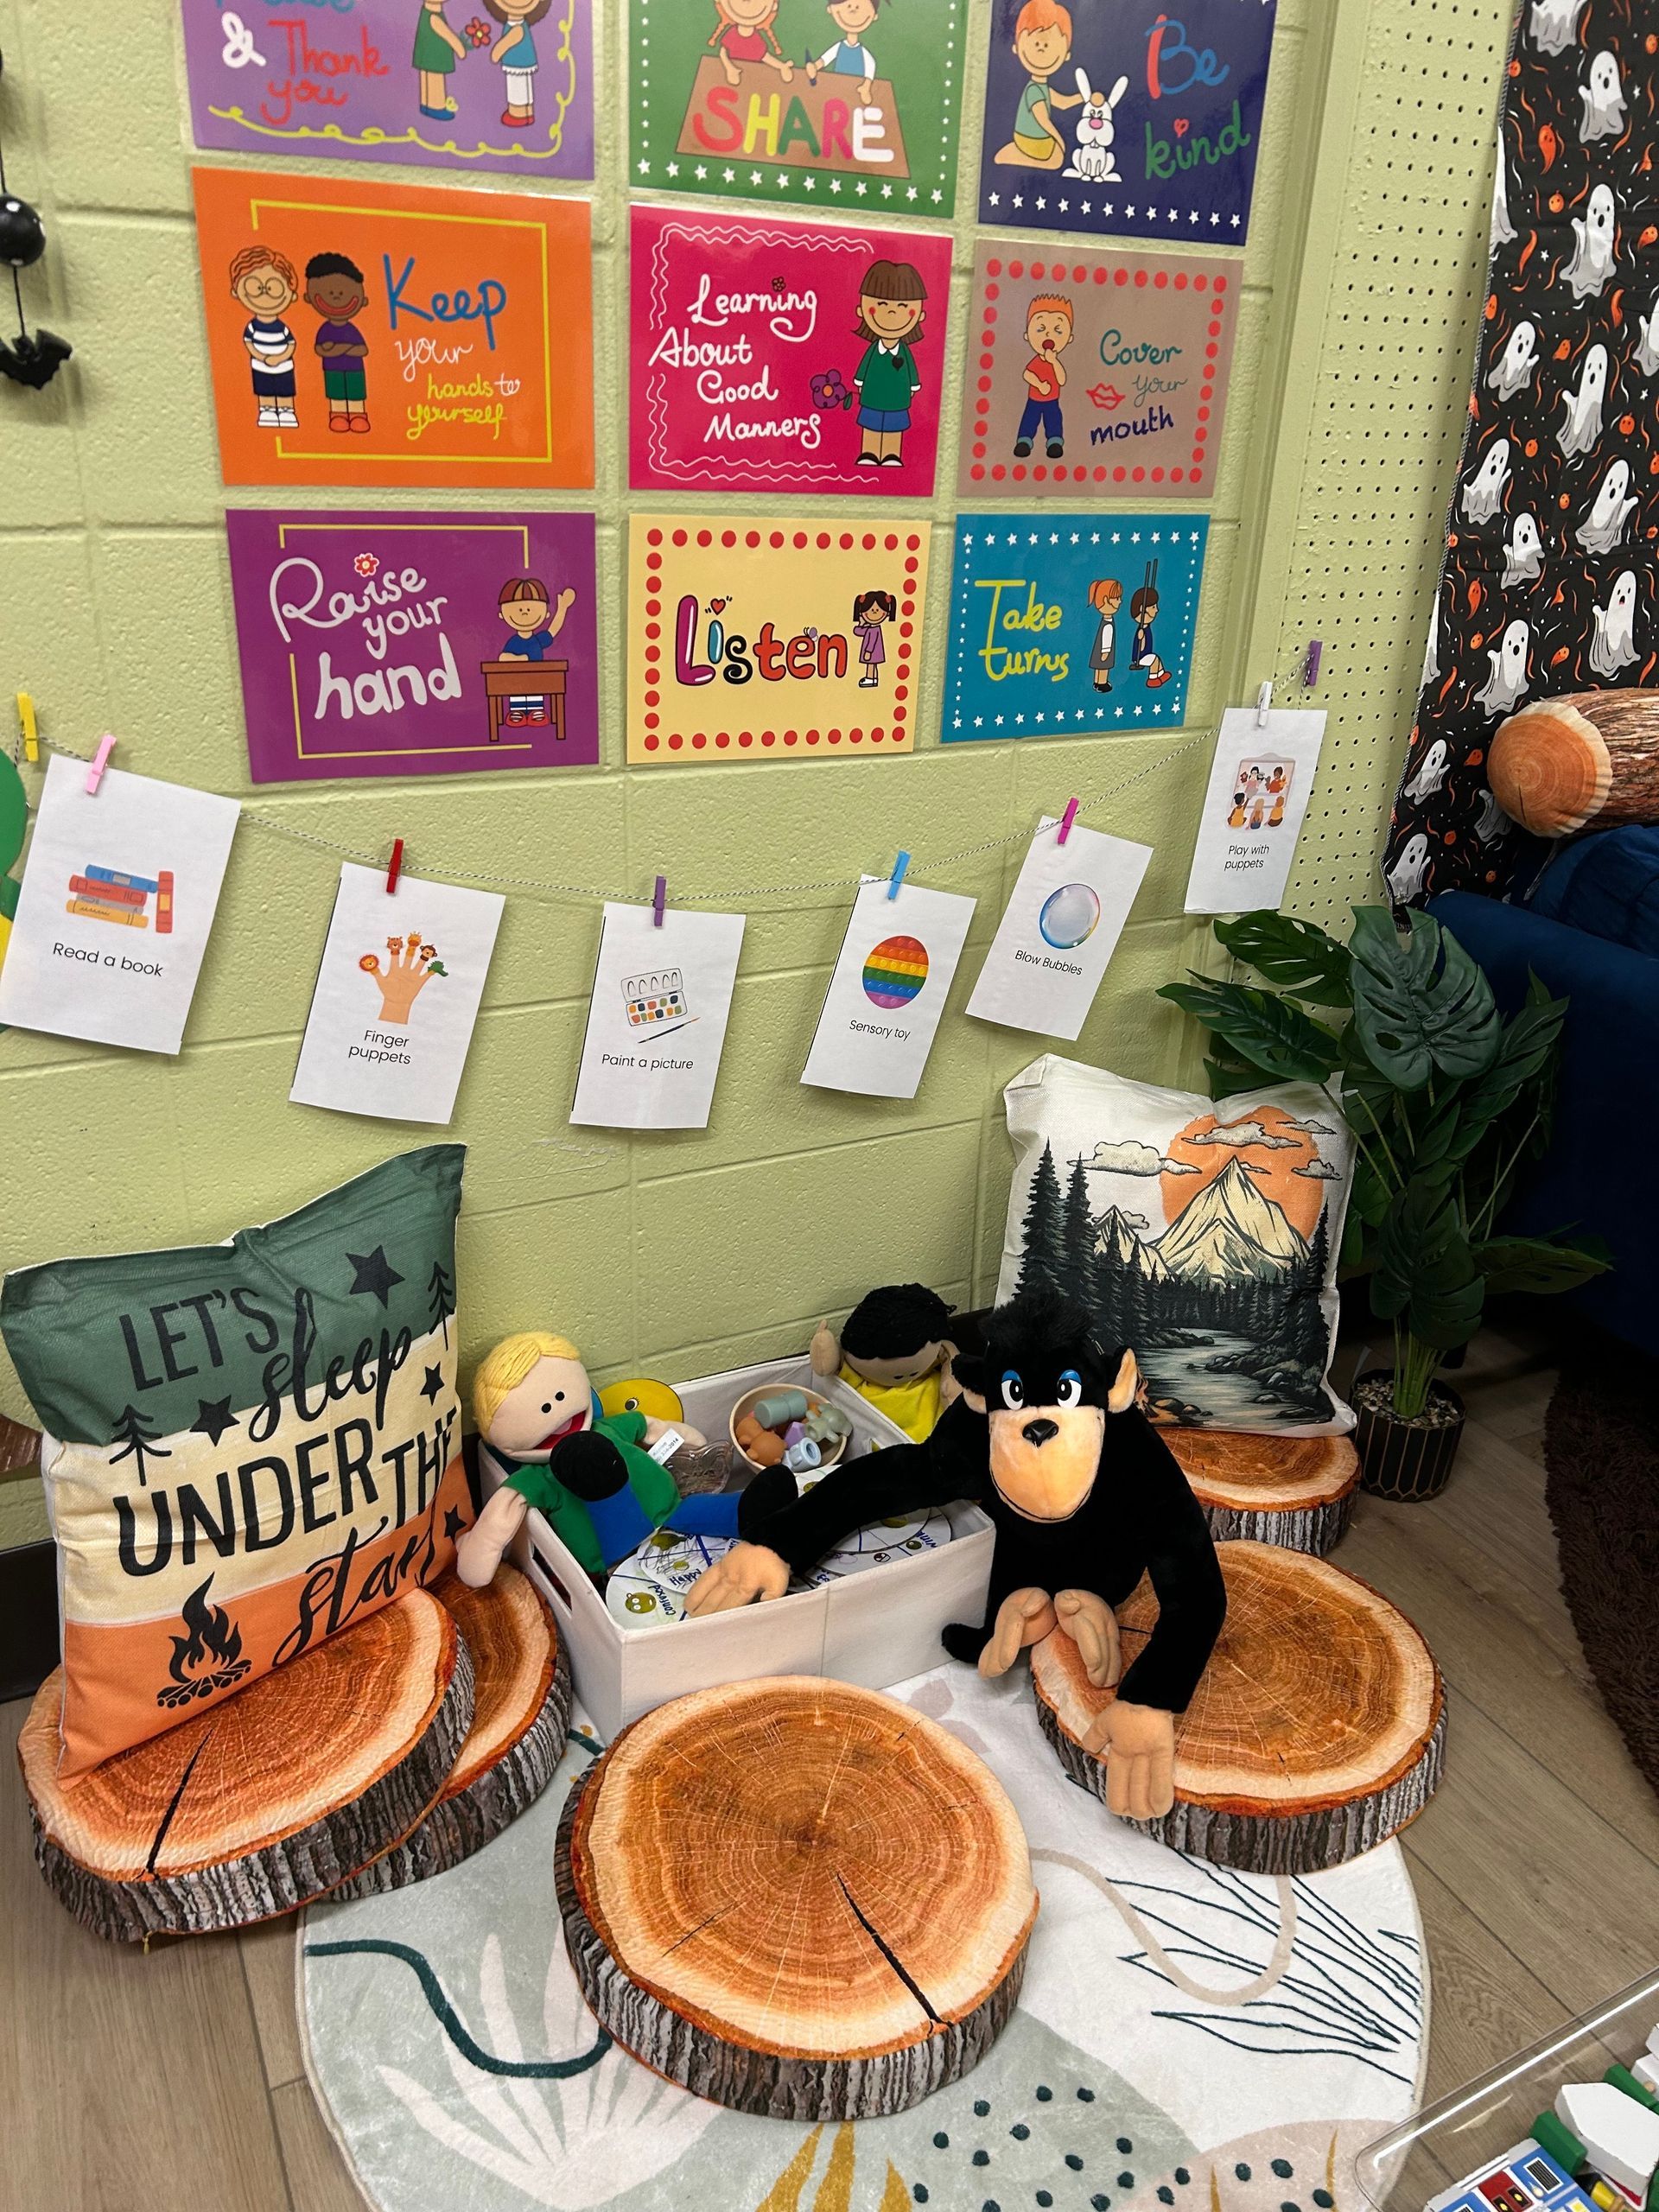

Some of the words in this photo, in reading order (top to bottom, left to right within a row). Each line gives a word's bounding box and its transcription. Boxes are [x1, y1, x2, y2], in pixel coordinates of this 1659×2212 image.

[222, 11, 267, 67] &
[267, 19, 391, 77] Thank
[1144, 14, 1230, 99] Be
[259, 77, 349, 126] you
[692, 86, 894, 163] SHARE
[1144, 99, 1251, 181] kind
[383, 253, 507, 352] Keep
[686, 272, 818, 343] Learning
[394, 336, 474, 383] your
[648, 325, 753, 369] About
[1099, 327, 1183, 366] Cover
[427, 372, 494, 400] hands
[494, 372, 521, 397] to
[696, 364, 779, 404] Good
[1131, 374, 1188, 408] your
[405, 403, 508, 442] yourself
[702, 411, 822, 450] Manners
[1090, 404, 1175, 446] mouth
[269, 555, 428, 644] Raise
[974, 578, 1064, 648] Take
[362, 596, 448, 660] your
[675, 594, 849, 687] Listen
[314, 631, 463, 721] hand
[978, 645, 1070, 683] turns
[1224, 858, 1264, 872] puppets
[1228, 844, 1249, 858] Play
[1250, 843, 1270, 855] with
[52, 942, 100, 964] Read
[103, 955, 117, 967] a
[120, 958, 164, 977] book
[1014, 950, 1042, 965] Blow
[1042, 957, 1084, 976] Bubbles
[363, 1029, 410, 1049] Finger
[849, 1020, 893, 1039] Sensory
[893, 1027, 912, 1042] toy
[347, 1044, 412, 1065] puppets
[601, 1053, 636, 1068] Paint
[638, 1058, 648, 1068] a
[650, 1057, 695, 1071] picture
[118, 1287, 281, 1392] LET'S
[248, 1287, 413, 1444] sleep
[112, 1416, 380, 1578] UNDER
